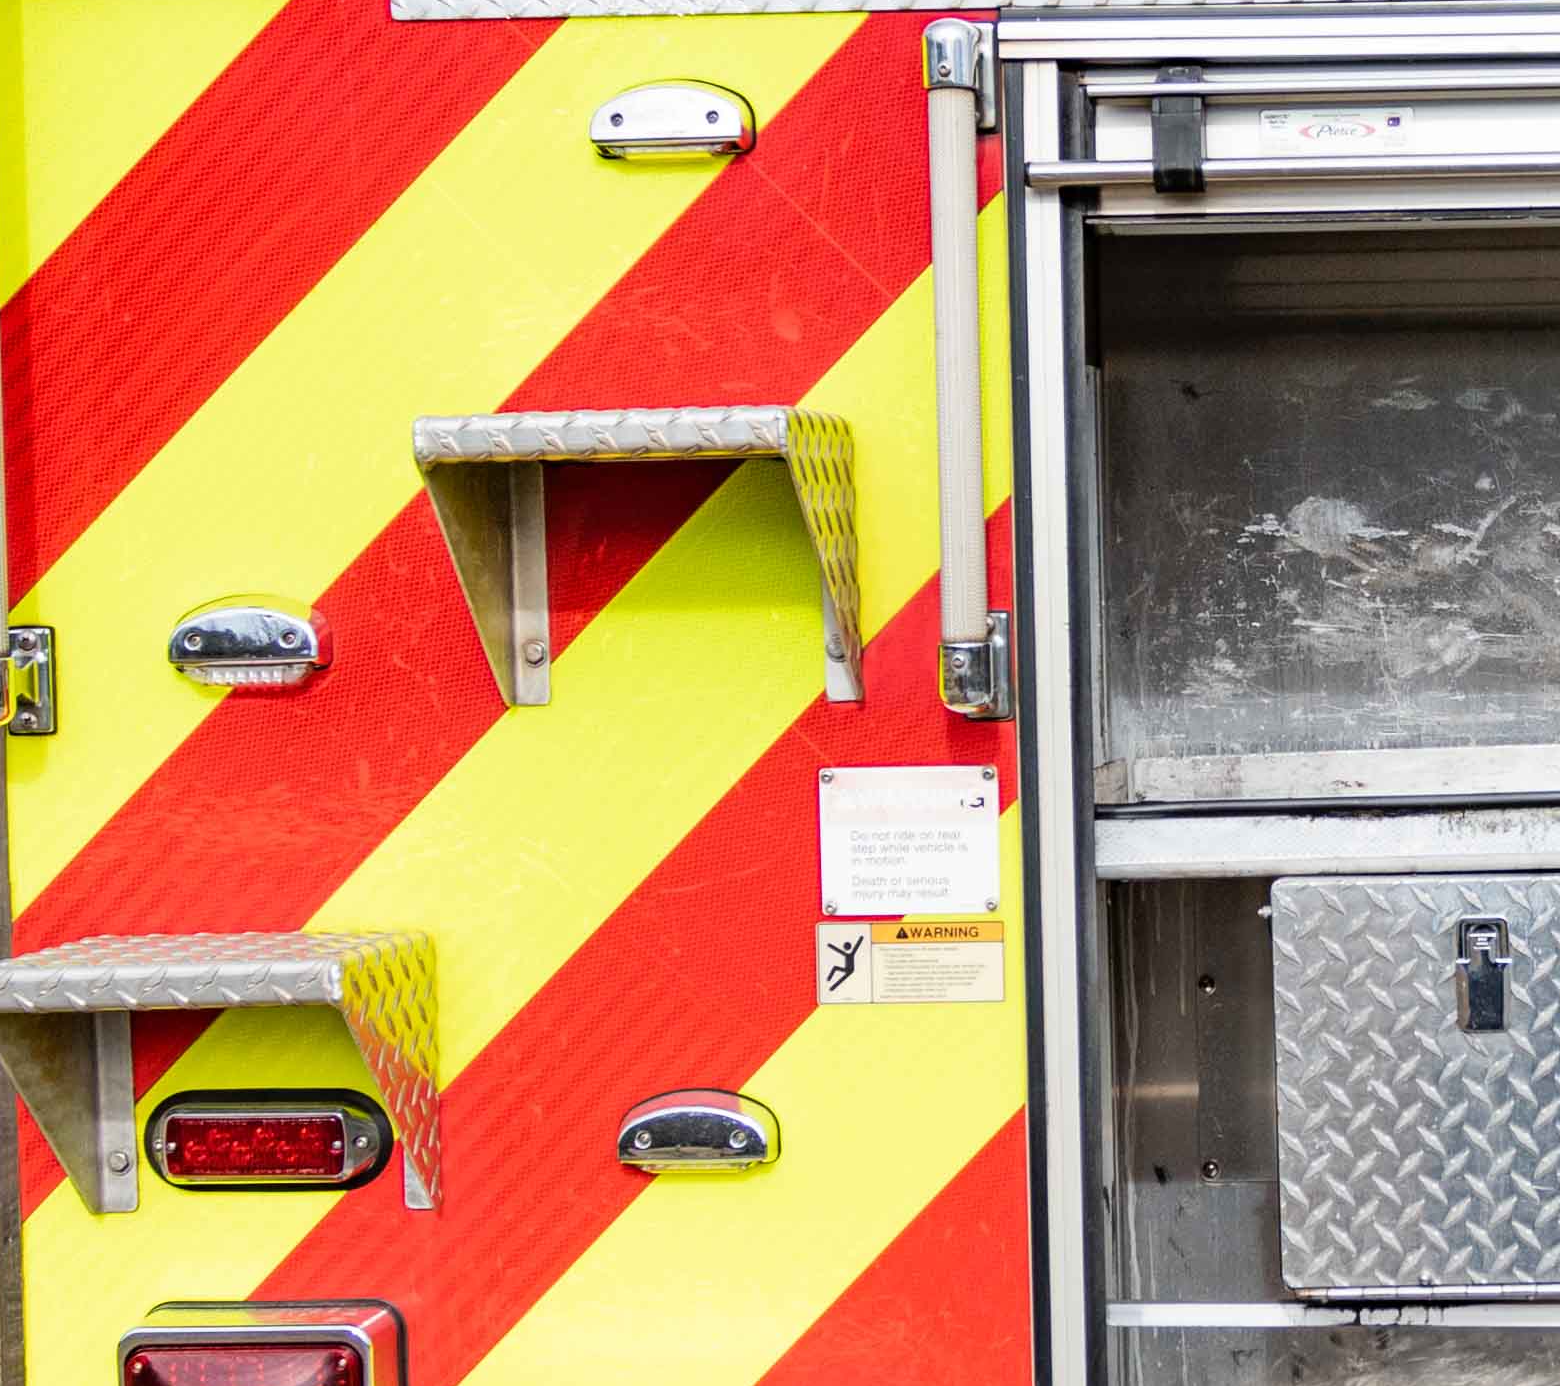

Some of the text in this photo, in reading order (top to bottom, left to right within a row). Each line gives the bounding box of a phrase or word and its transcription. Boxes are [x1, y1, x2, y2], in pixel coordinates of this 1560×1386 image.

[849, 829, 961, 842] Do not ride on rear
[851, 842, 969, 856] step while vehicle is
[851, 875, 888, 886] Death
[906, 874, 951, 886] serious
[852, 888, 884, 901] injury
[886, 888, 913, 902] may
[910, 926, 979, 939] WARNING
